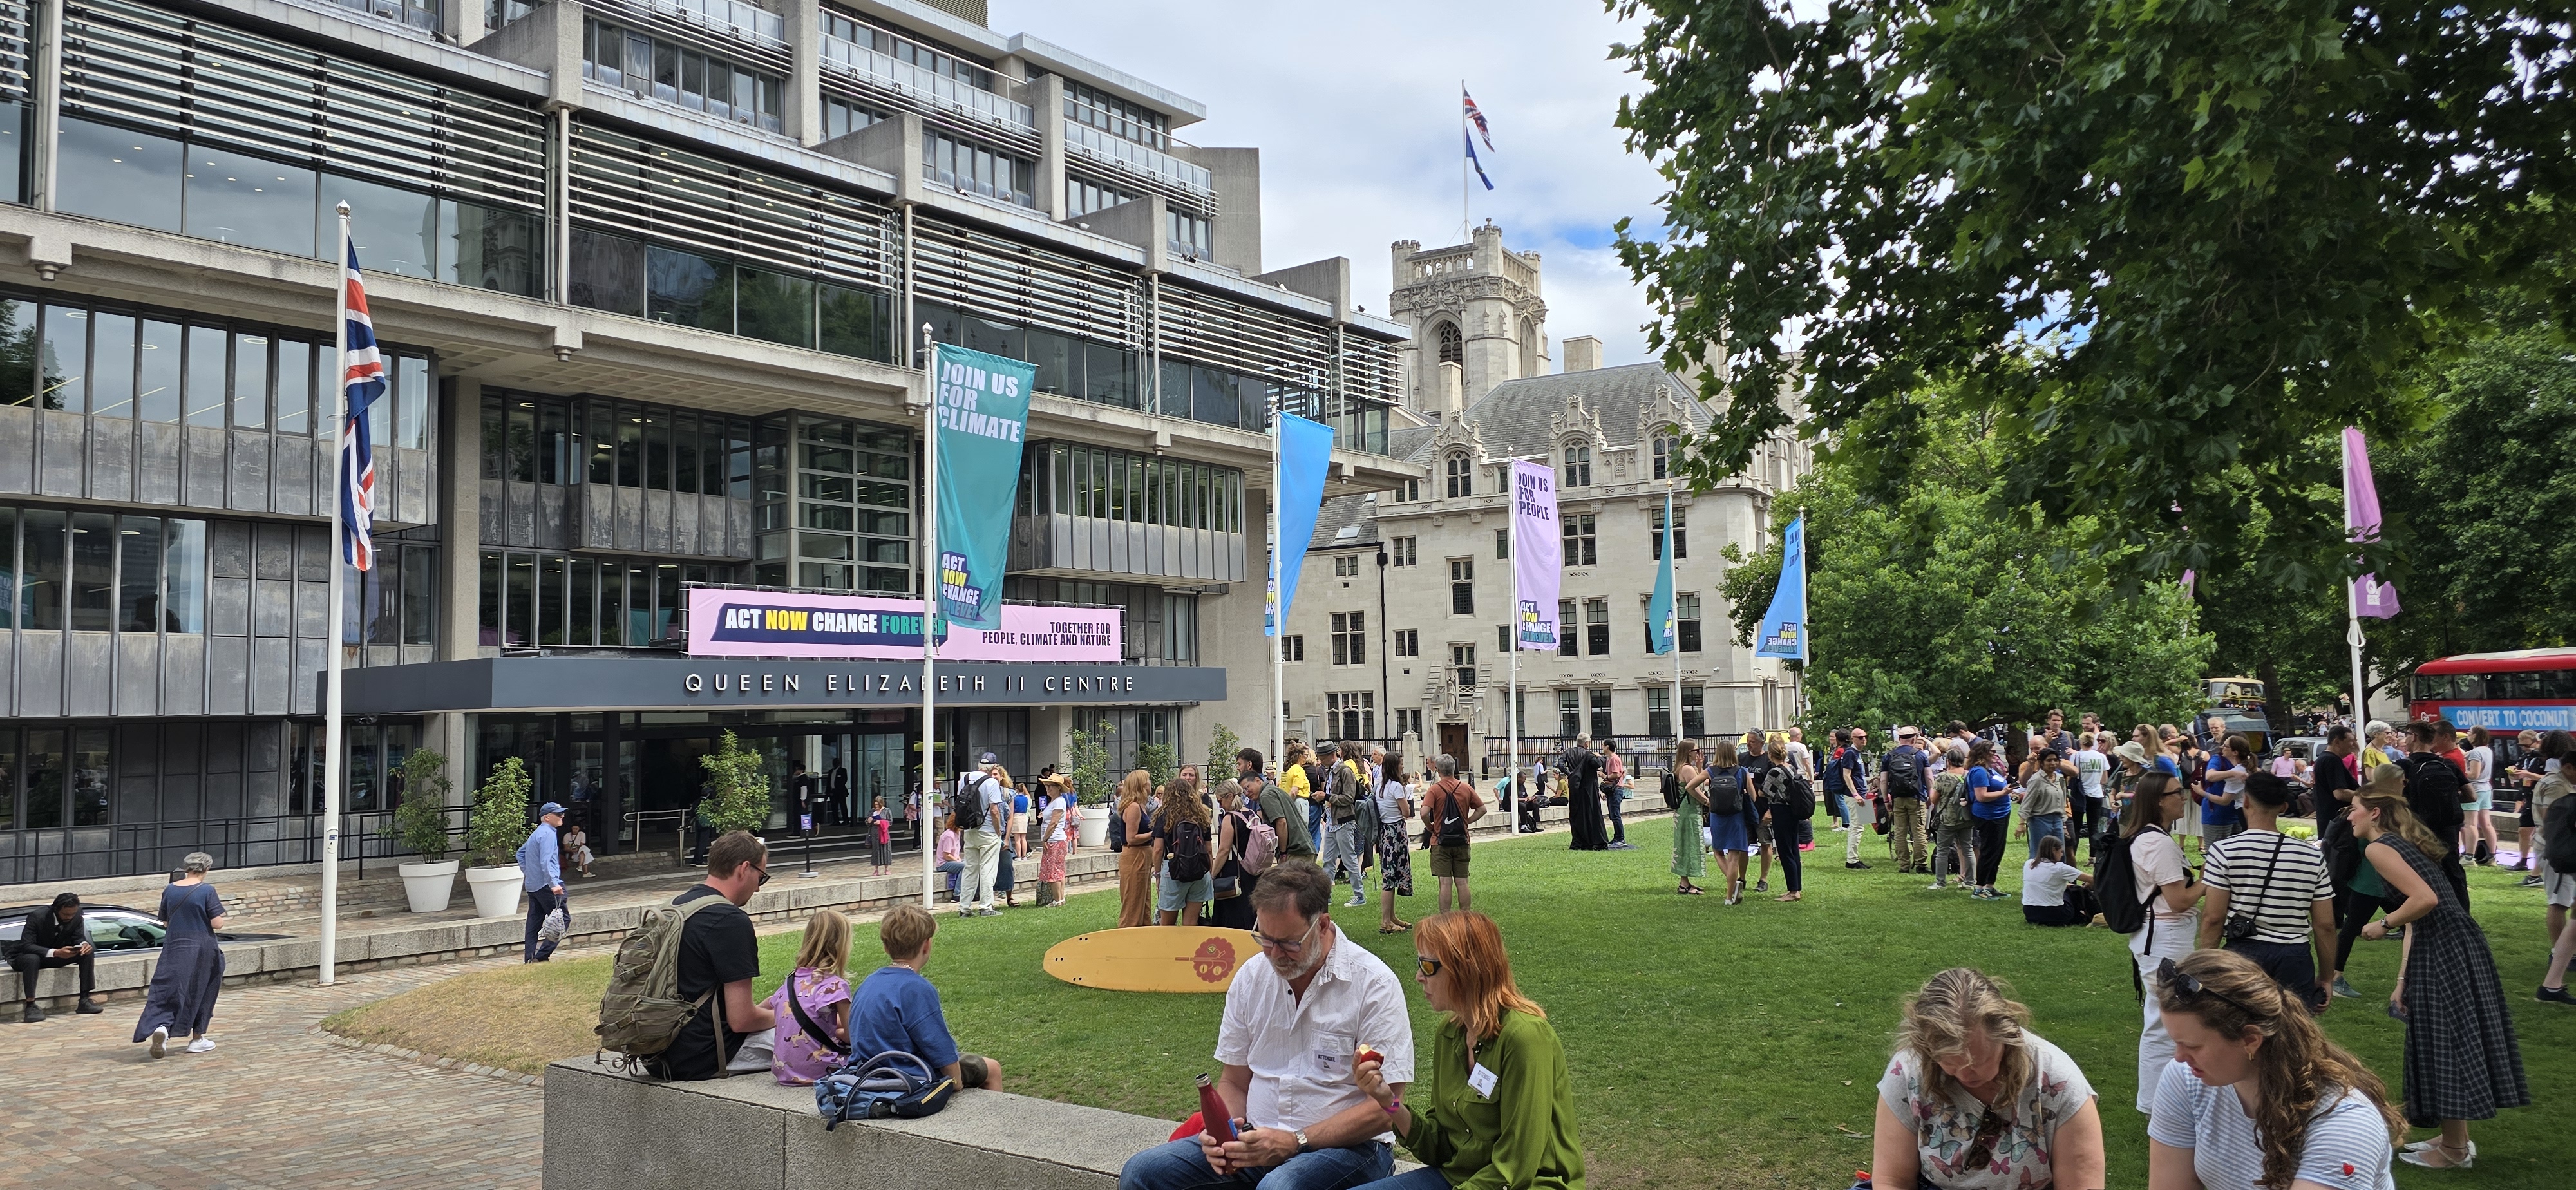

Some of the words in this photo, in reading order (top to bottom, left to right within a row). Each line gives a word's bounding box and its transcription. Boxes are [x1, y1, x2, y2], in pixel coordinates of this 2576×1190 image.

[941, 361, 986, 391] JOIN
[992, 372, 1018, 397] US
[939, 382, 978, 411] FOR
[938, 405, 1021, 442] CLIMATE
[1519, 472, 1535, 489] JOIN
[1538, 477, 1548, 492] US
[1519, 486, 1535, 502] FOR
[1519, 501, 1549, 520] PEOPLE
[942, 554, 965, 571] ACT
[942, 569, 967, 587] NOW
[942, 583, 979, 605] CHANGE
[1520, 601, 1534, 612] ACT
[725, 609, 761, 630] ACT
[766, 610, 808, 631] NOW
[813, 612, 877, 633] CHANGE
[1522, 612, 1537, 623] NOW
[1050, 621, 1094, 634] TOGETHER
[1096, 623, 1111, 634] FOR
[1522, 621, 1551, 633] CHANGE
[982, 632, 1018, 646] PEOPLE,
[1020, 633, 1057, 645] CLIMATE
[1060, 634, 1077, 645] AND
[1080, 634, 1111, 646] NATURE
[685, 674, 799, 692] QUEEN
[1008, 676, 1024, 690] II
[1045, 676, 1133, 691] CENTRE
[2456, 710, 2500, 726] CONVERT
[2502, 710, 2517, 726] TO
[2519, 710, 2569, 727] COCONUT
